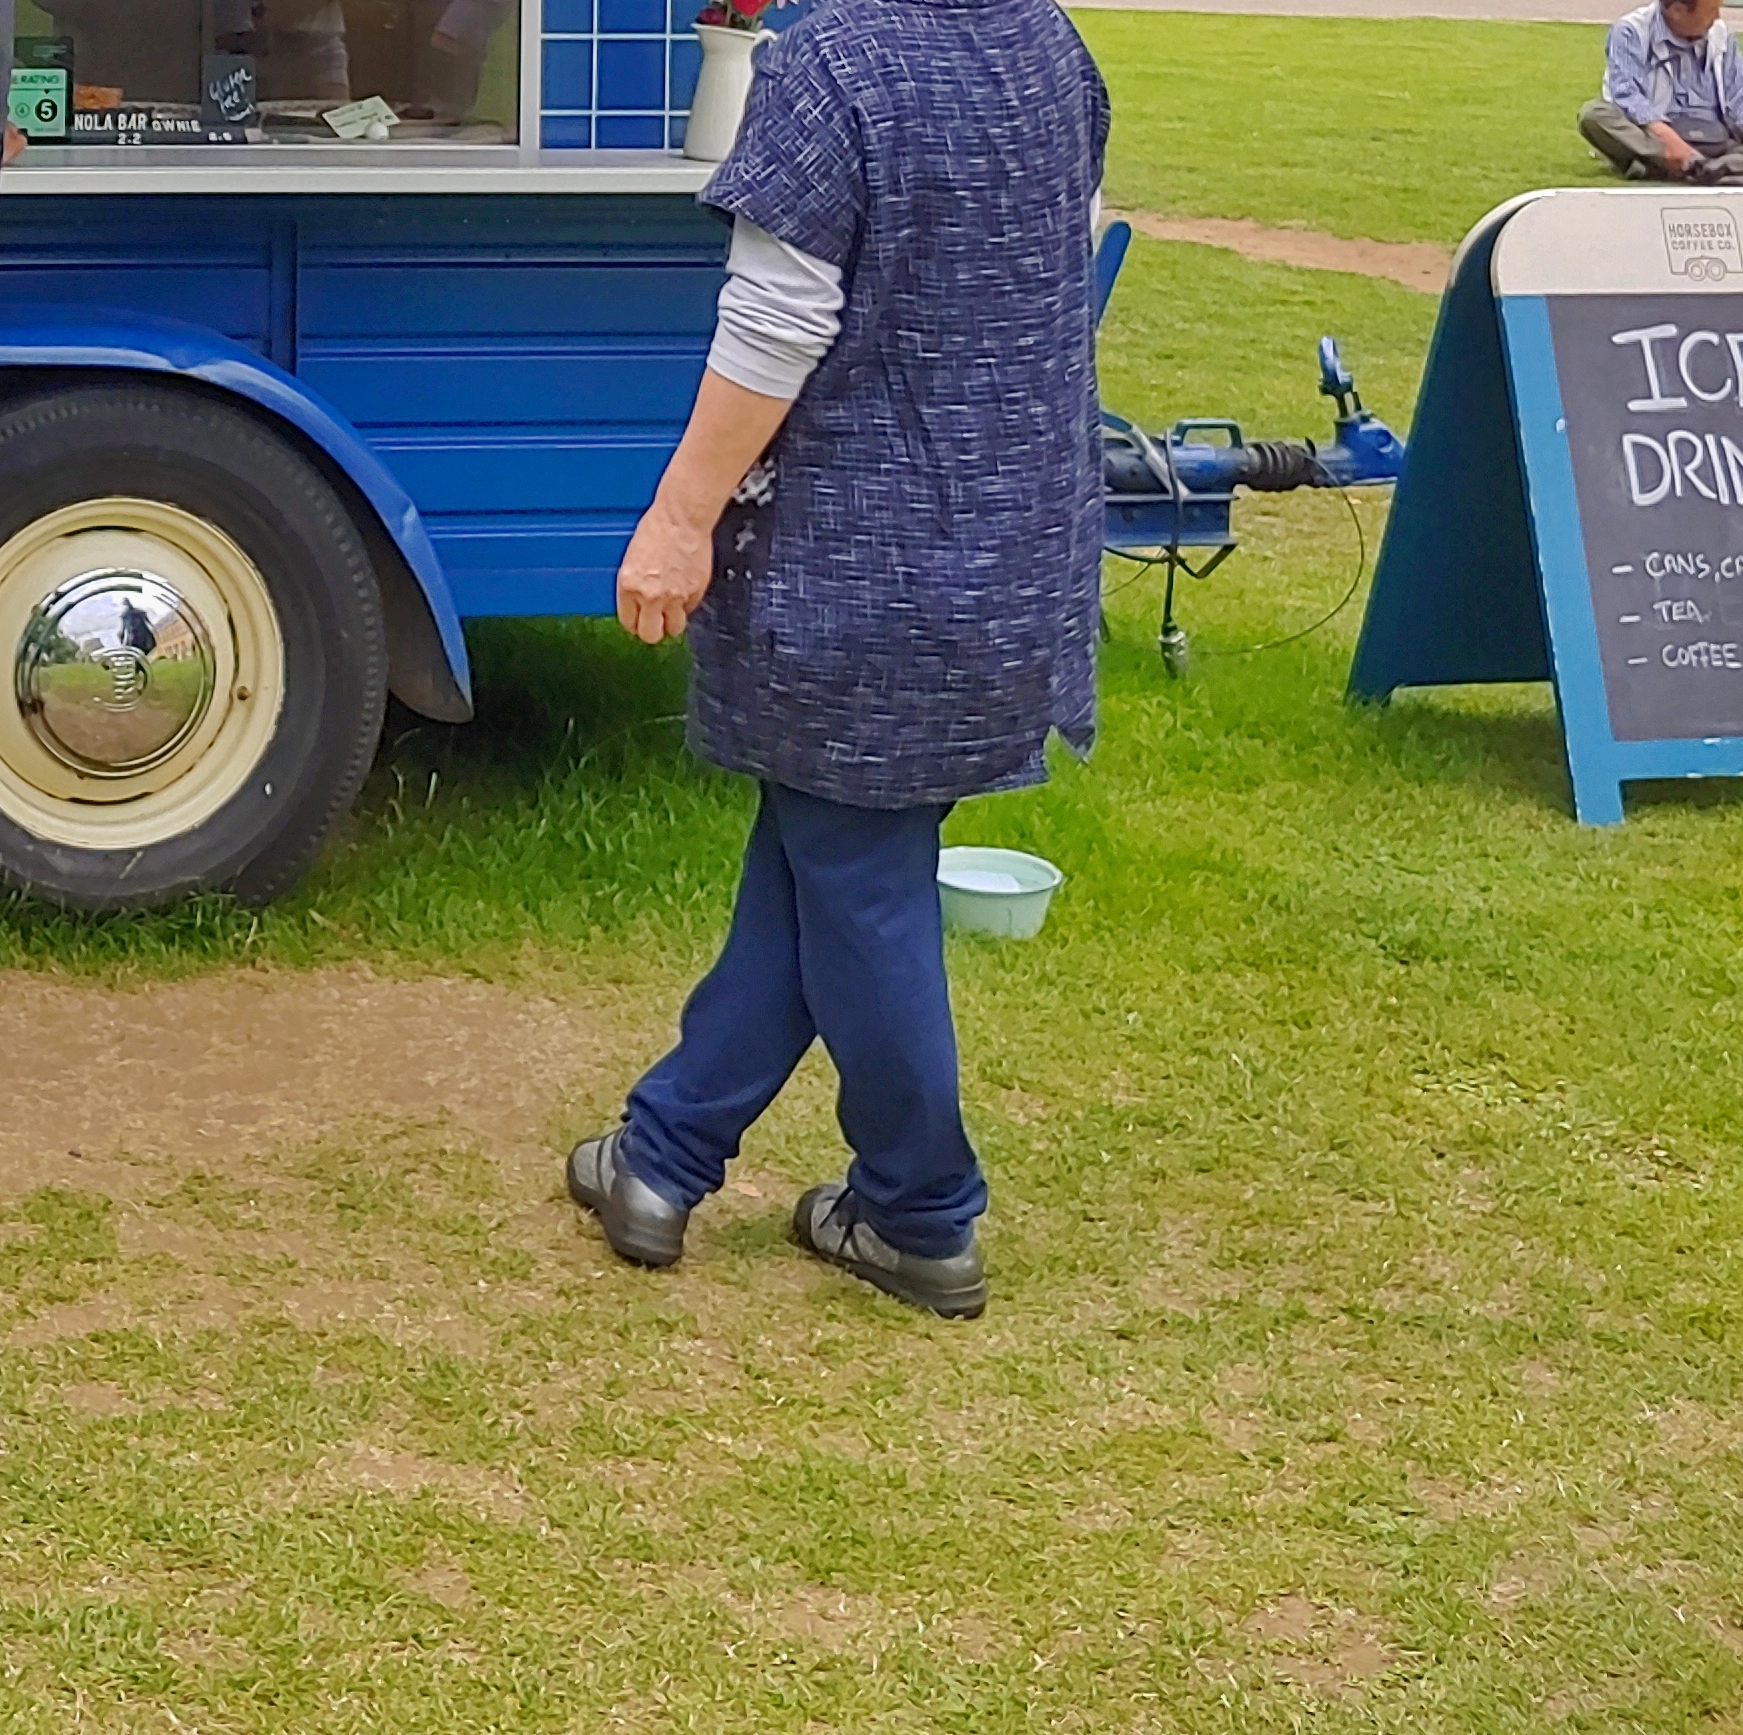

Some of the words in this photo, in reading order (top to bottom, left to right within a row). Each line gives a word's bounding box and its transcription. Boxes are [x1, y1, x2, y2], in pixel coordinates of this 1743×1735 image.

[41, 102, 53, 120] 5
[74, 114, 114, 131] NOLA
[118, 114, 148, 131] BAR
[152, 120, 202, 133] OWNIE
[117, 133, 142, 145] 2.2
[1669, 222, 1733, 238] HORSEBOX
[1671, 239, 1714, 250] COFFEE
[1653, 599, 1704, 624] TEA
[1662, 641, 1743, 669] COFFEE
